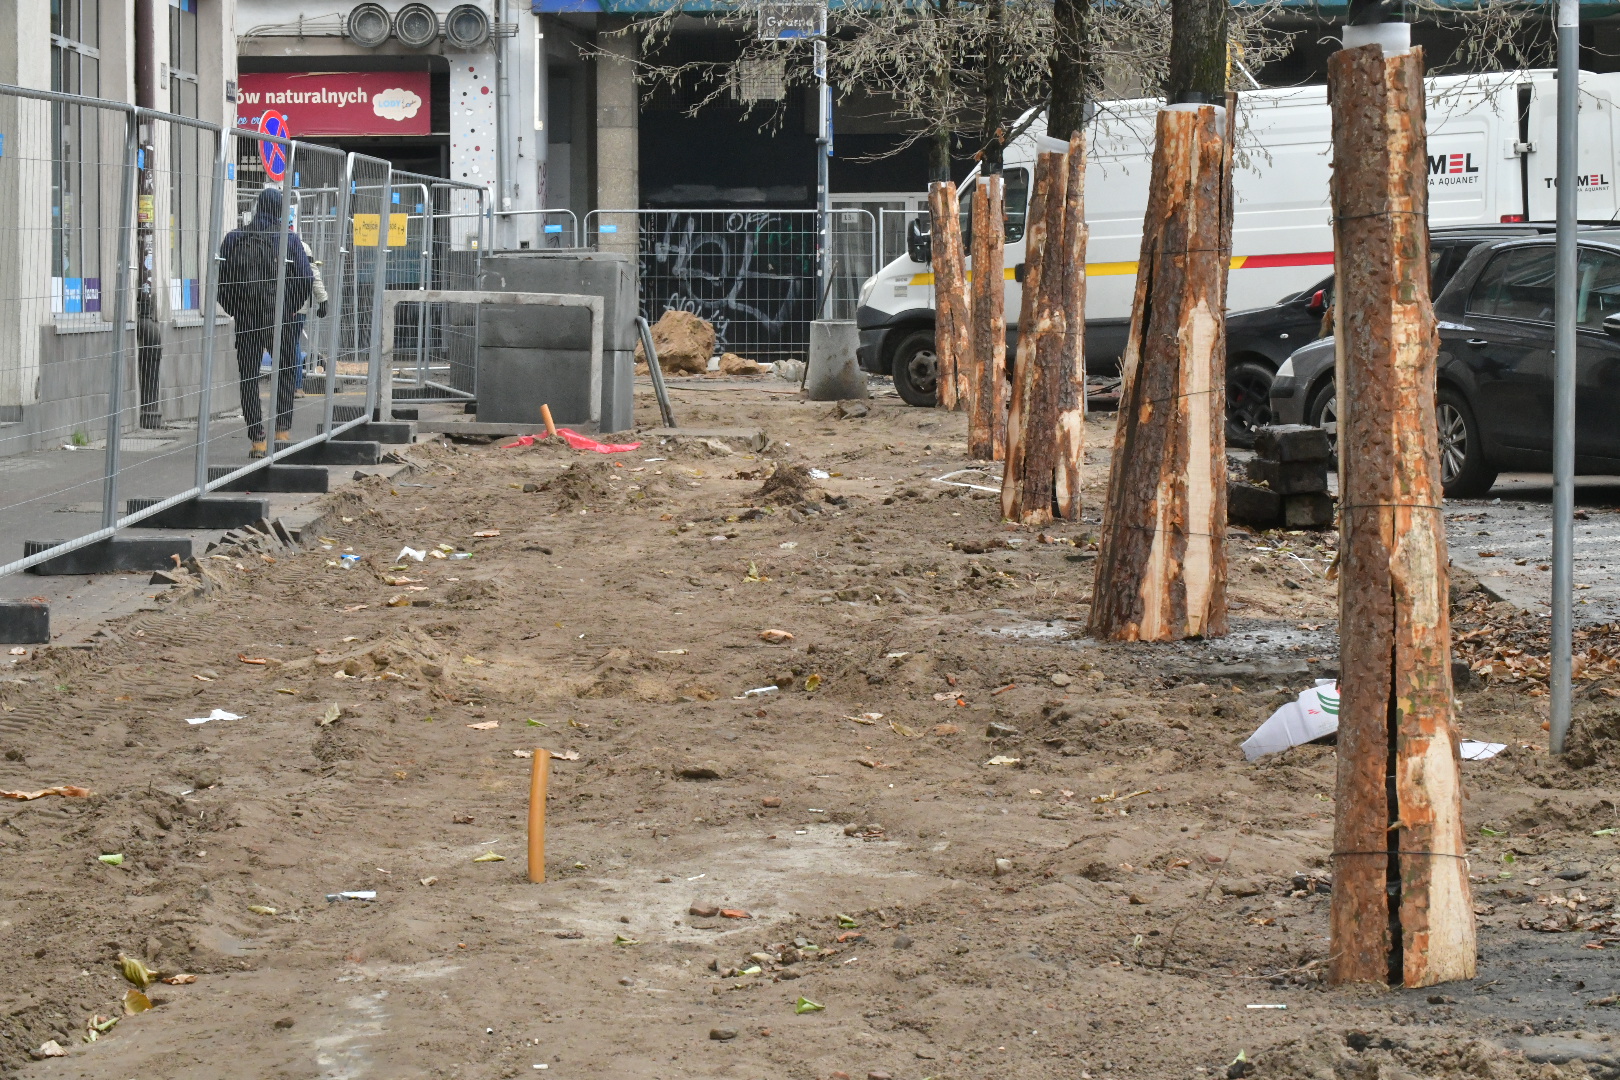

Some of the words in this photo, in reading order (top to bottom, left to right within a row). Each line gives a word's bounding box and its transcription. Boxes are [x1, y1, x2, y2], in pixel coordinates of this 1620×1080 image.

[265, 87, 368, 108] naturalnych
[378, 99, 401, 108] LODY
[1438, 175, 1479, 187] AQUANET
